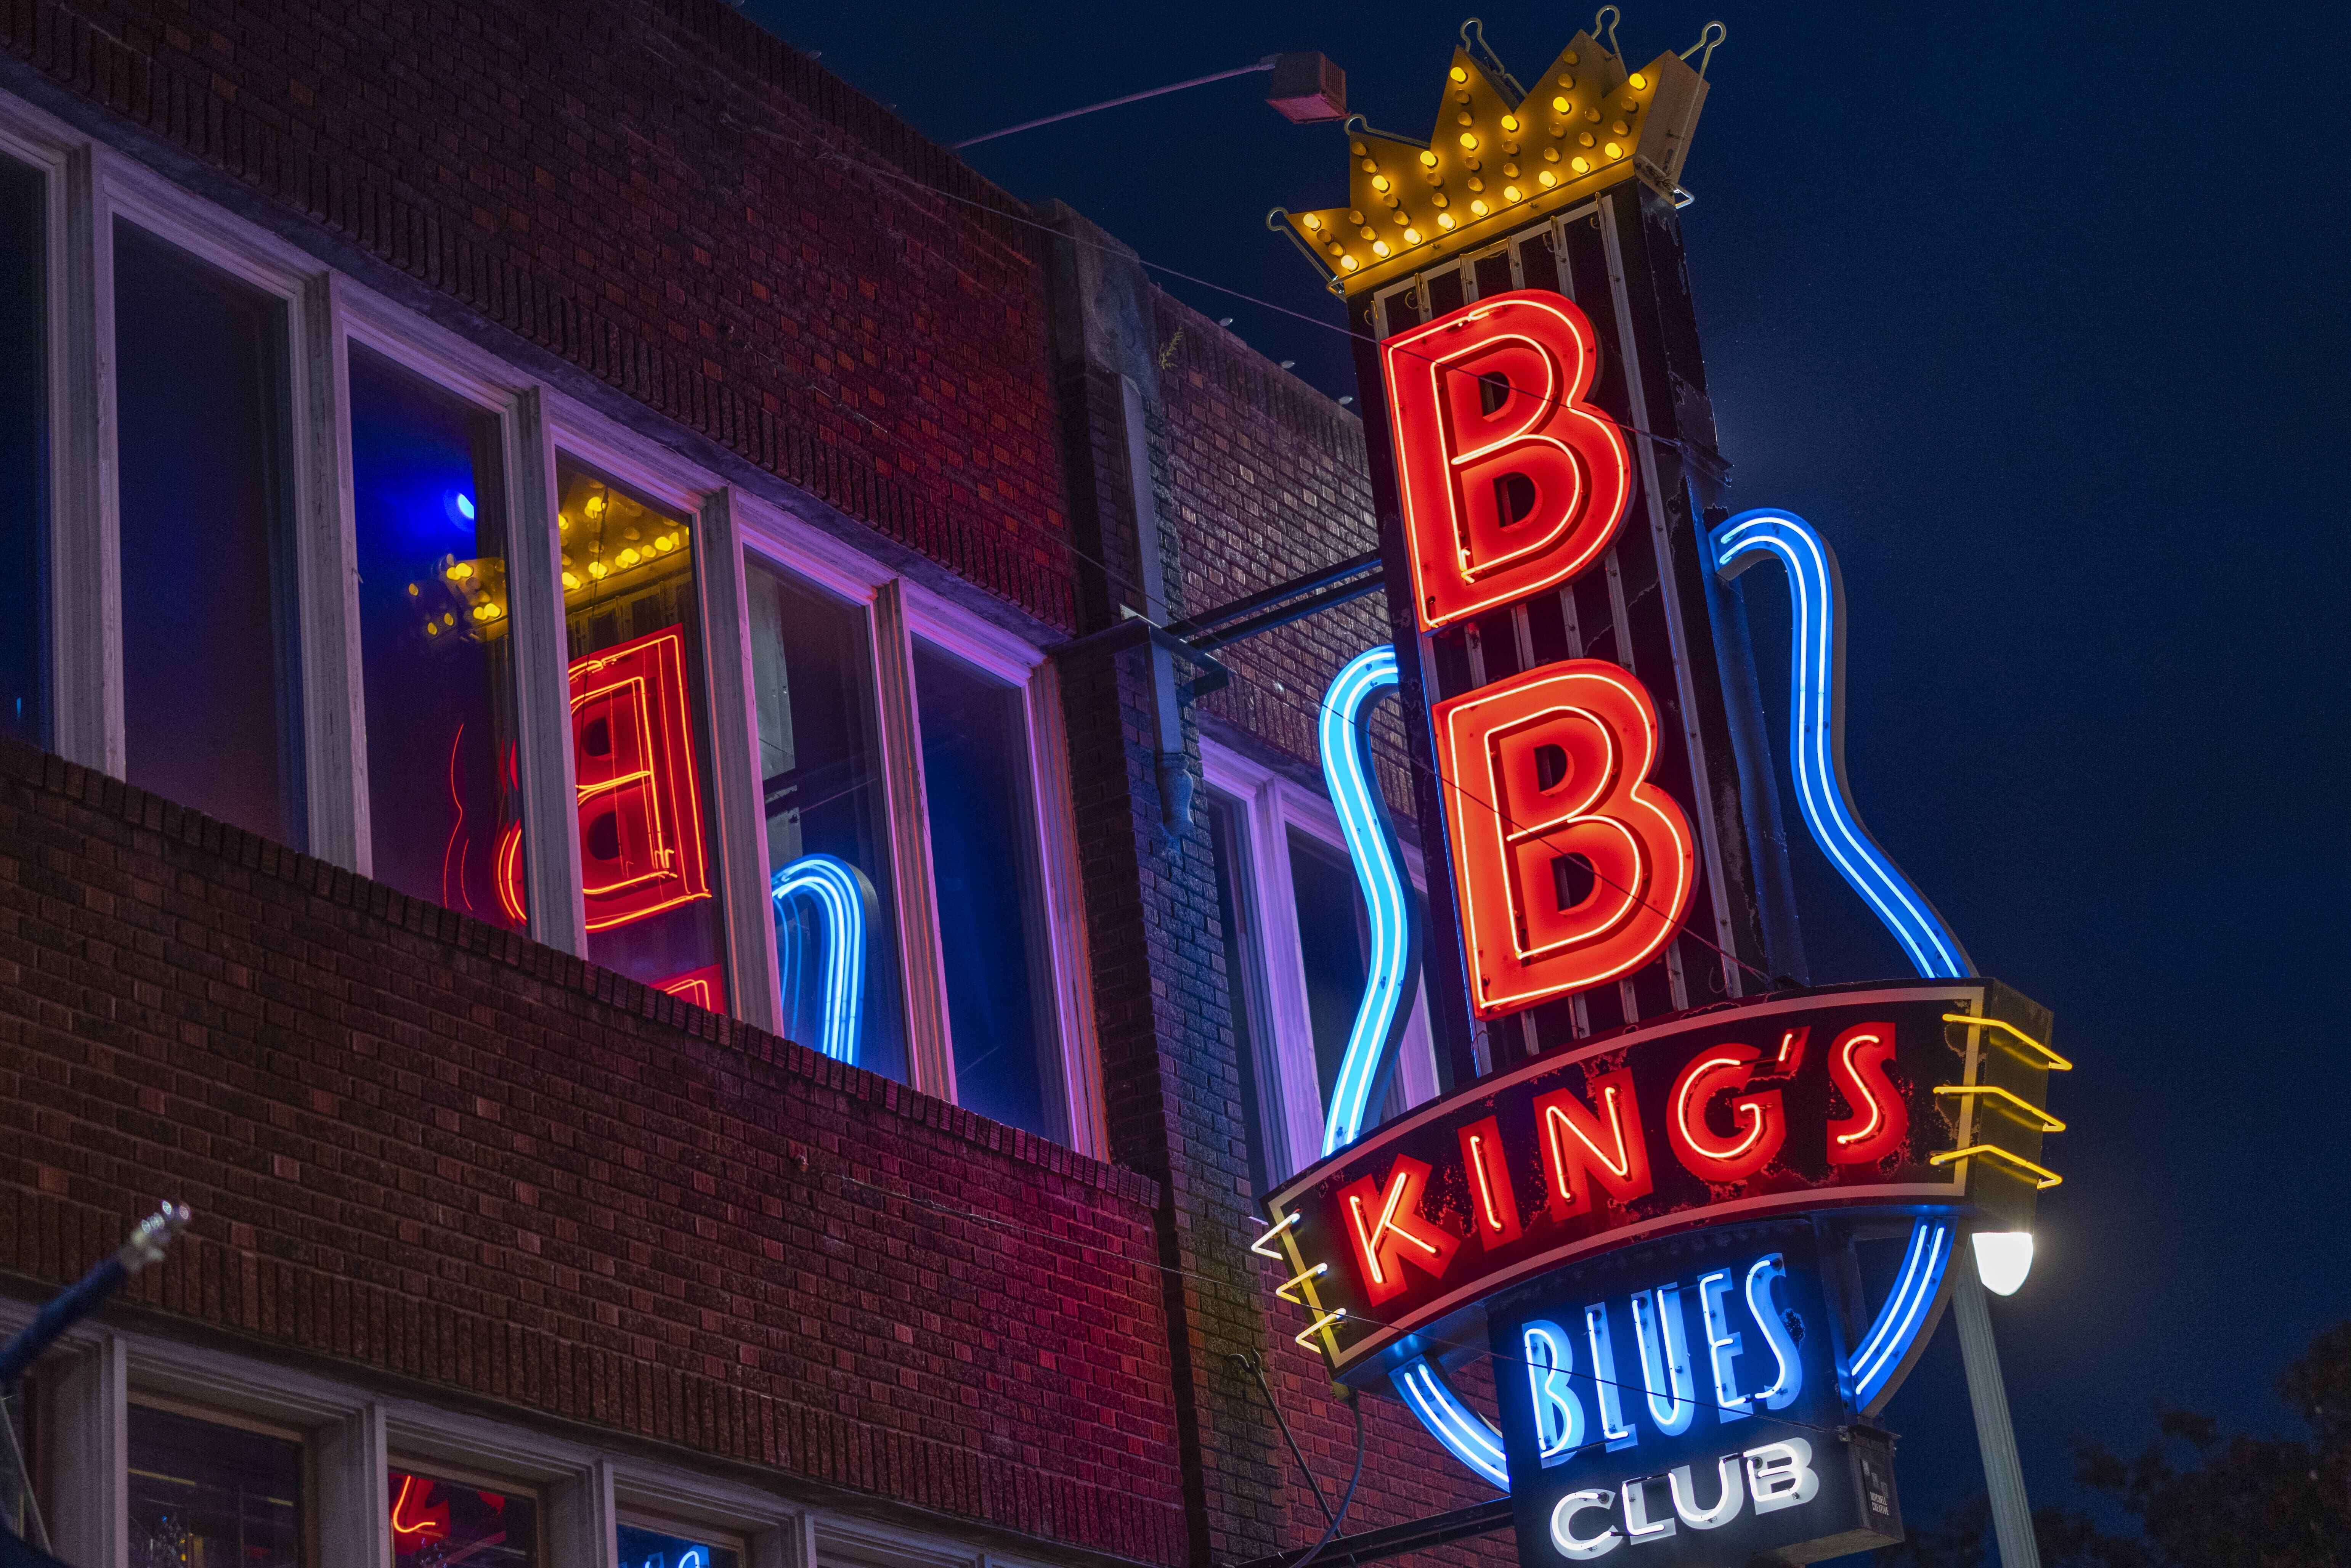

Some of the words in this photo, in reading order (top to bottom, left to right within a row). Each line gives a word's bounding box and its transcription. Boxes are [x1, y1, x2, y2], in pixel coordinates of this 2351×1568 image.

[1380, 290, 1637, 633] B
[1432, 658, 1698, 1022] B
[1337, 1022, 1908, 1307] KING'S
[1521, 1253, 1802, 1469] BLUES
[1550, 1437, 1819, 1560] CLUB
[1870, 1491, 1887, 1505] MITCHELL
[1872, 1501, 1889, 1516] CREATIVE
